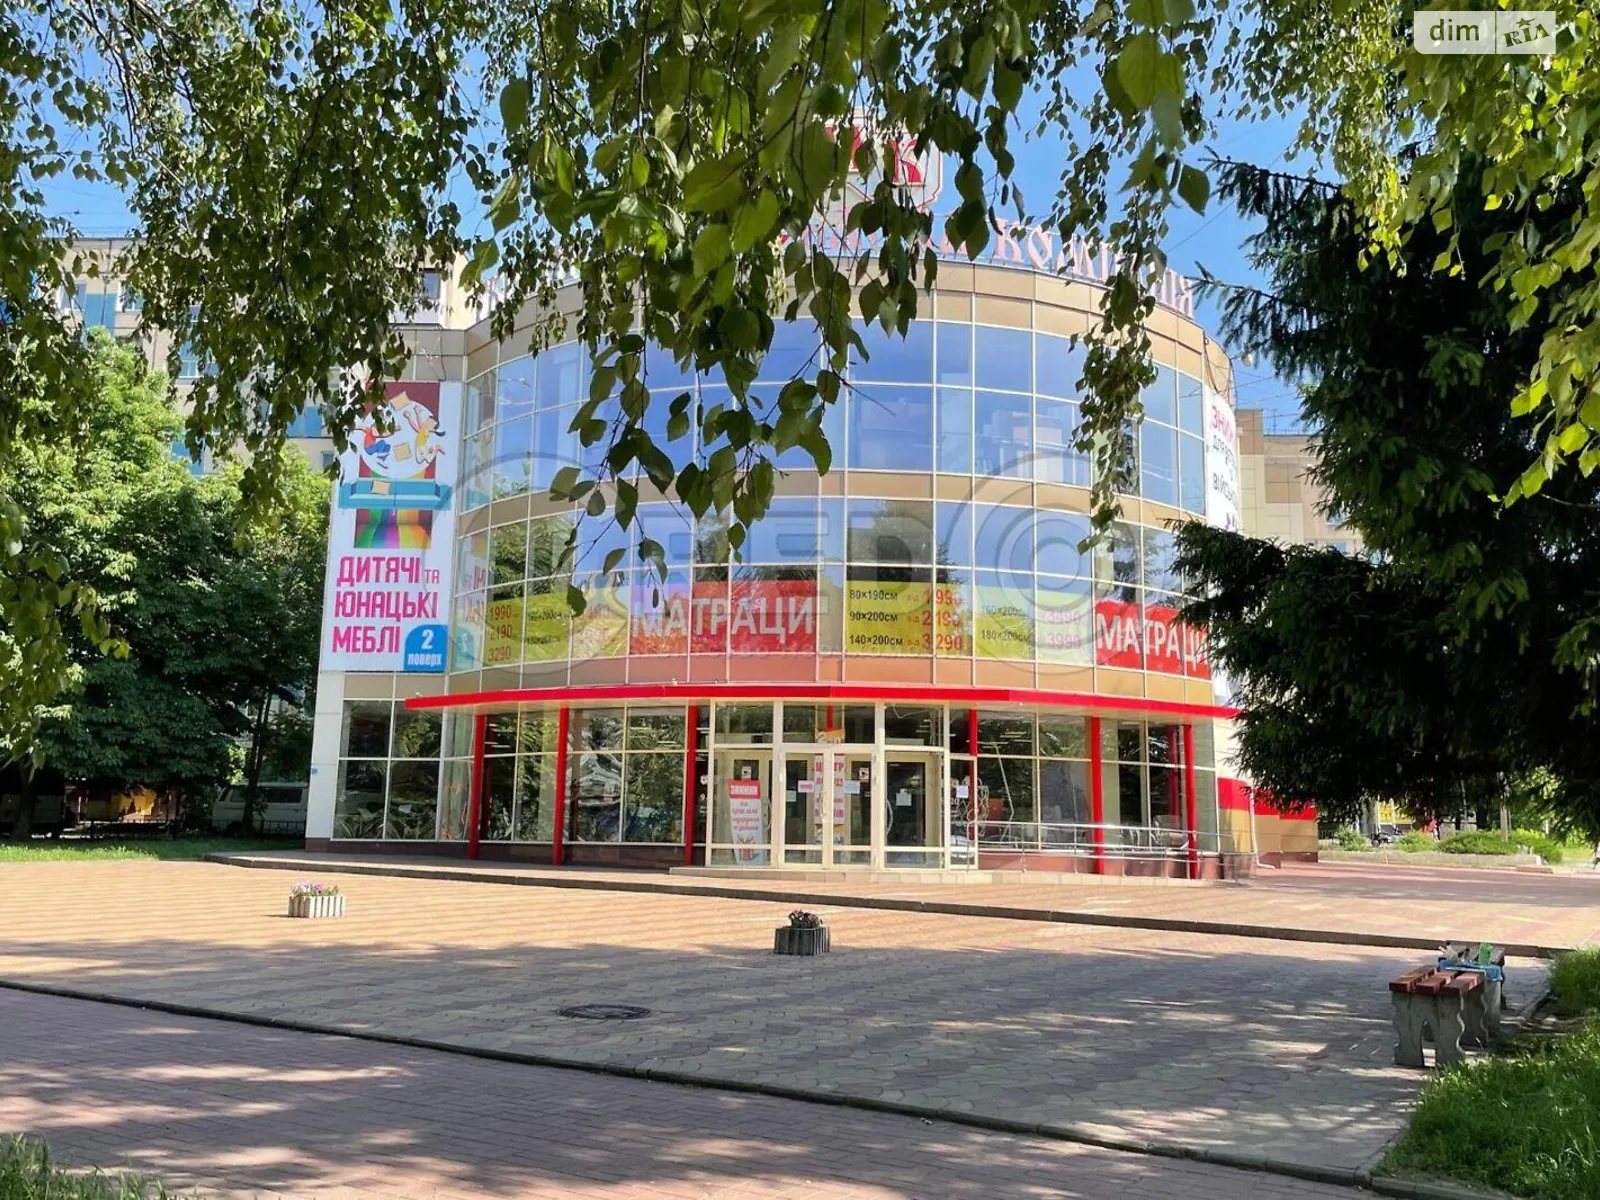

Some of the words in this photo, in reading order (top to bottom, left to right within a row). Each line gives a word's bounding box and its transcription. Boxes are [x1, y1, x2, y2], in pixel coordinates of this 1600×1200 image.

[336, 556, 421, 587] ДИТЯЧІ
[424, 569, 440, 584] ТА
[334, 591, 438, 622] ЮНАЦЬКІ
[633, 596, 813, 643] МАТРАЦИ
[332, 626, 400, 653] МЕБЛІ
[421, 628, 434, 650] 2
[922, 633, 963, 650] 3290
[407, 652, 442, 666] поверх
